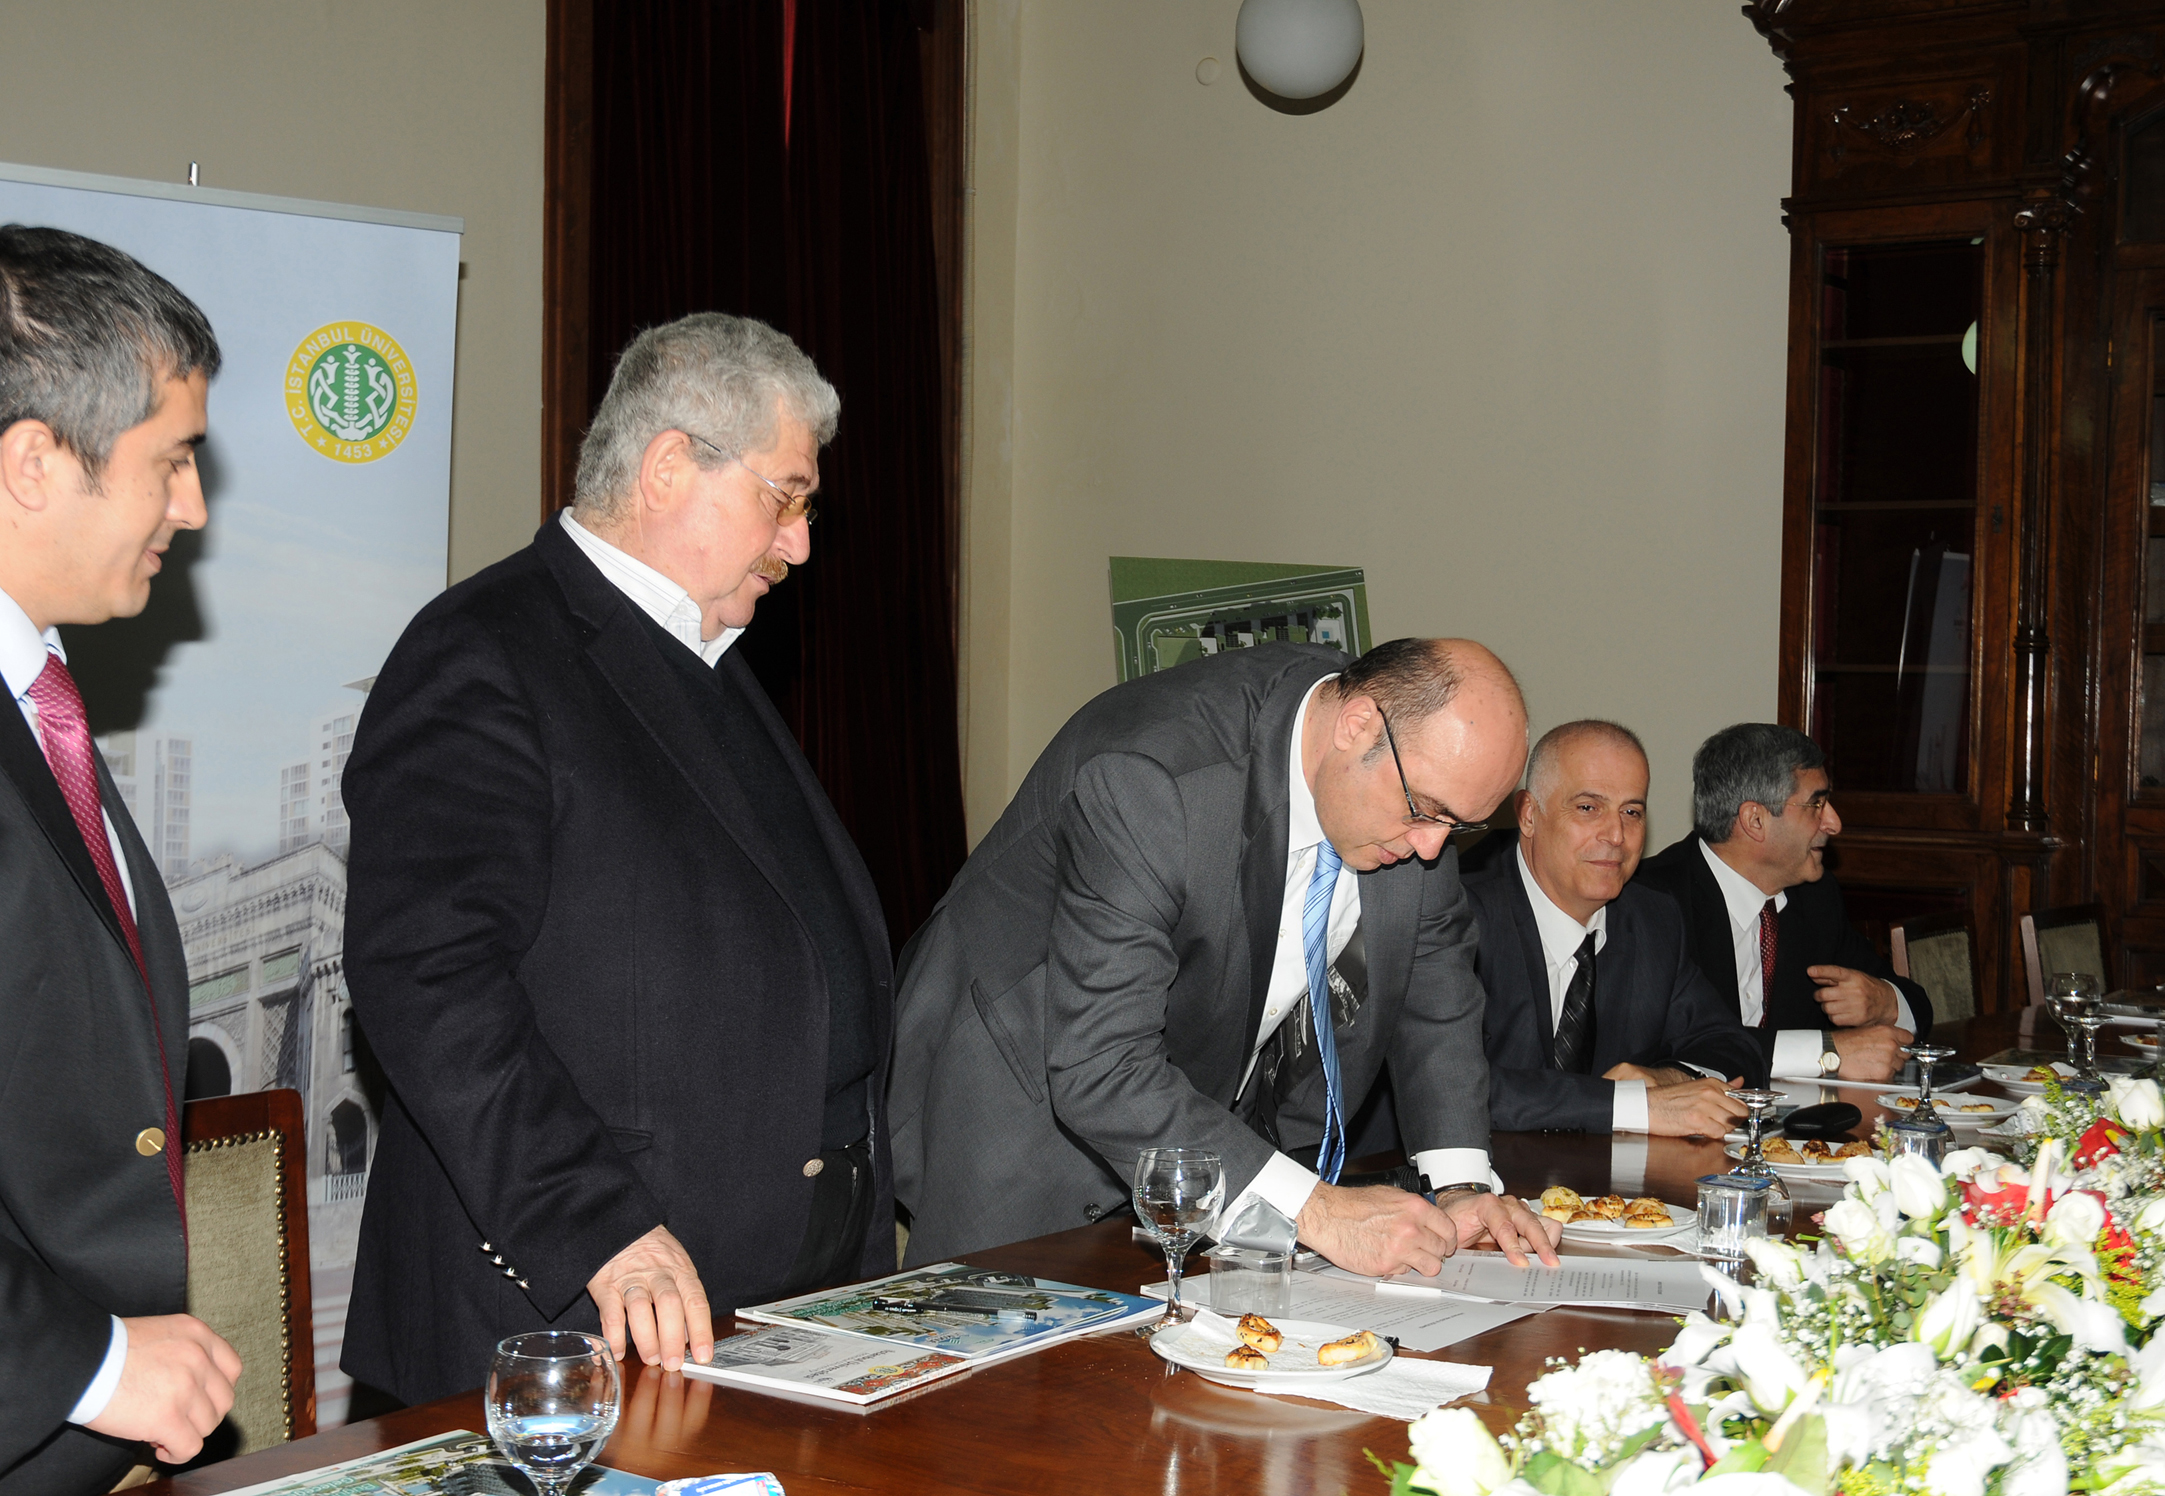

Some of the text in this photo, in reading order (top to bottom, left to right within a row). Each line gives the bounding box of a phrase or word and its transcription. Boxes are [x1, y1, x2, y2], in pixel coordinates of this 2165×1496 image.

[286, 327, 416, 447] T.C. İSTANBUL ÜNİVERSİTESİ
[334, 443, 373, 459] 1453
